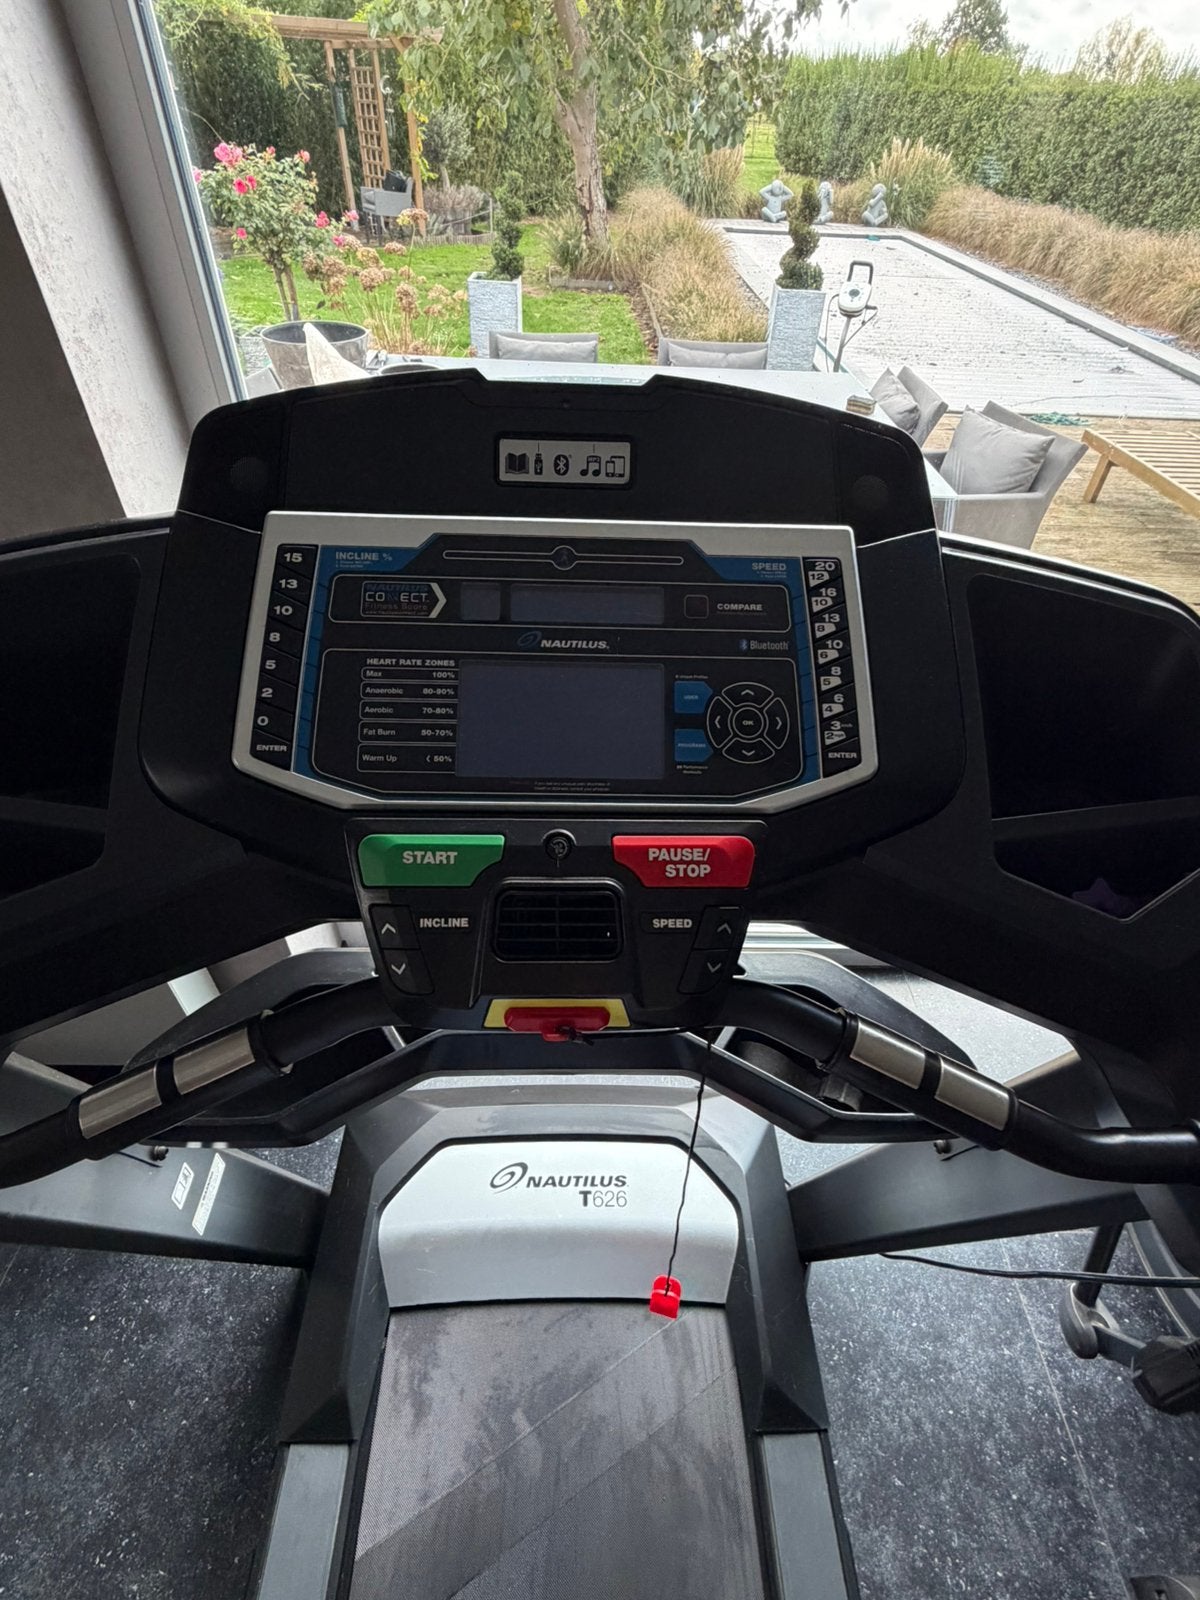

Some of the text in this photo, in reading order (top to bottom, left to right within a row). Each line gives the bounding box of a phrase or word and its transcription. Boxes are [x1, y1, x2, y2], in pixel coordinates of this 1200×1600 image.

[284, 553, 303, 562] 15
[335, 552, 393, 561] INCLINE %
[752, 563, 787, 571] SPEED
[815, 562, 836, 571] 20
[810, 573, 825, 581] 12
[279, 580, 298, 588] 13
[820, 588, 837, 597] 16
[274, 606, 293, 615] 10
[717, 603, 763, 611] COMPARE
[823, 613, 841, 622] 13
[269, 632, 280, 642] 8
[540, 639, 607, 649] NAUTILUS
[750, 640, 789, 650] Bluetooth
[826, 640, 844, 649] 10
[820, 651, 828, 659] 6
[265, 660, 276, 669] 5
[366, 658, 455, 667] HEART RATE ZONES
[831, 666, 842, 676] 8
[261, 688, 273, 698] 2
[834, 694, 844, 703] 6
[364, 706, 394, 714] Aerobic
[825, 705, 834, 713] 4
[257, 716, 268, 726] 0
[830, 721, 841, 730] 3
[363, 728, 375, 736] Fat
[377, 728, 396, 736] Burn
[256, 744, 288, 752] ENTER
[386, 755, 397, 763] Up
[402, 851, 458, 865] START
[648, 848, 710, 863] PAUSE/
[665, 864, 712, 878] STOP
[420, 918, 469, 928] INCLINE
[652, 918, 693, 929] SPEED
[526, 1175, 627, 1188] NAUTILUS
[579, 1190, 627, 1208] T626
